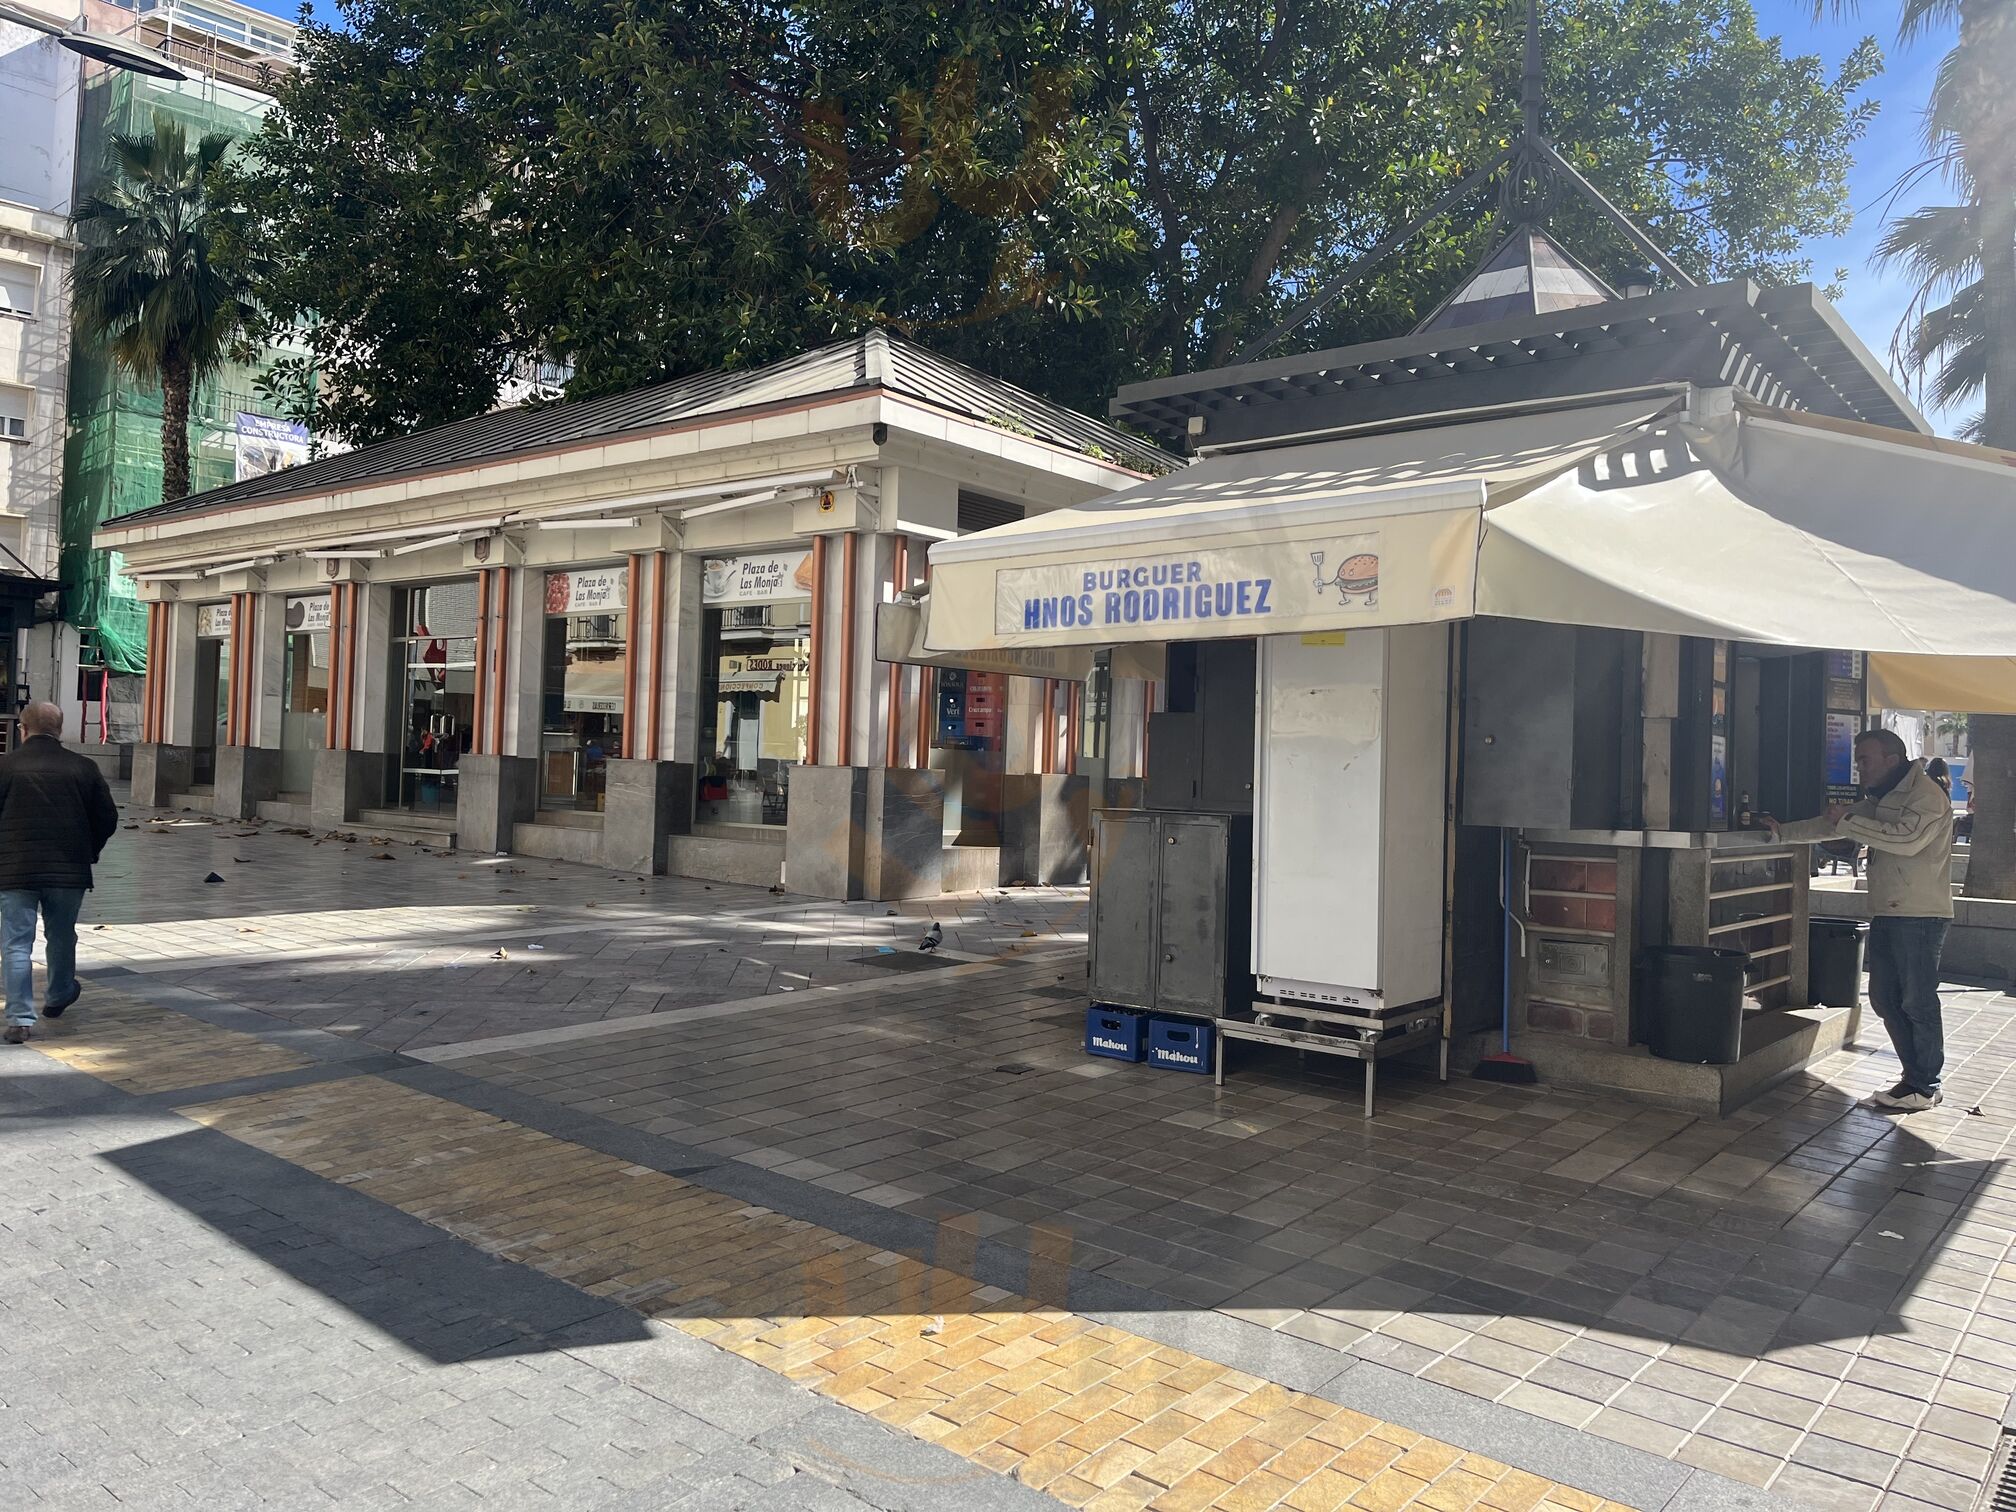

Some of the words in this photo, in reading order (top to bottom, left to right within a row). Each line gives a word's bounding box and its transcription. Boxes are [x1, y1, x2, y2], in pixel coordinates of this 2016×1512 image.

[255, 418, 291, 433] EMPRESA
[241, 425, 304, 444] CONSTRUCTORA
[742, 561, 766, 575] Plaza
[768, 560, 779, 573] de
[577, 576, 596, 588] Plaza
[598, 575, 607, 587] de
[740, 577, 752, 589] Las
[1083, 561, 1201, 592] BURGUER
[575, 590, 586, 601] Las
[1024, 594, 1093, 630] HNOS
[1105, 579, 1272, 624] RODRIGUEZ
[1092, 1036, 1128, 1052] Mahou
[1157, 1048, 1198, 1064] Mahou
